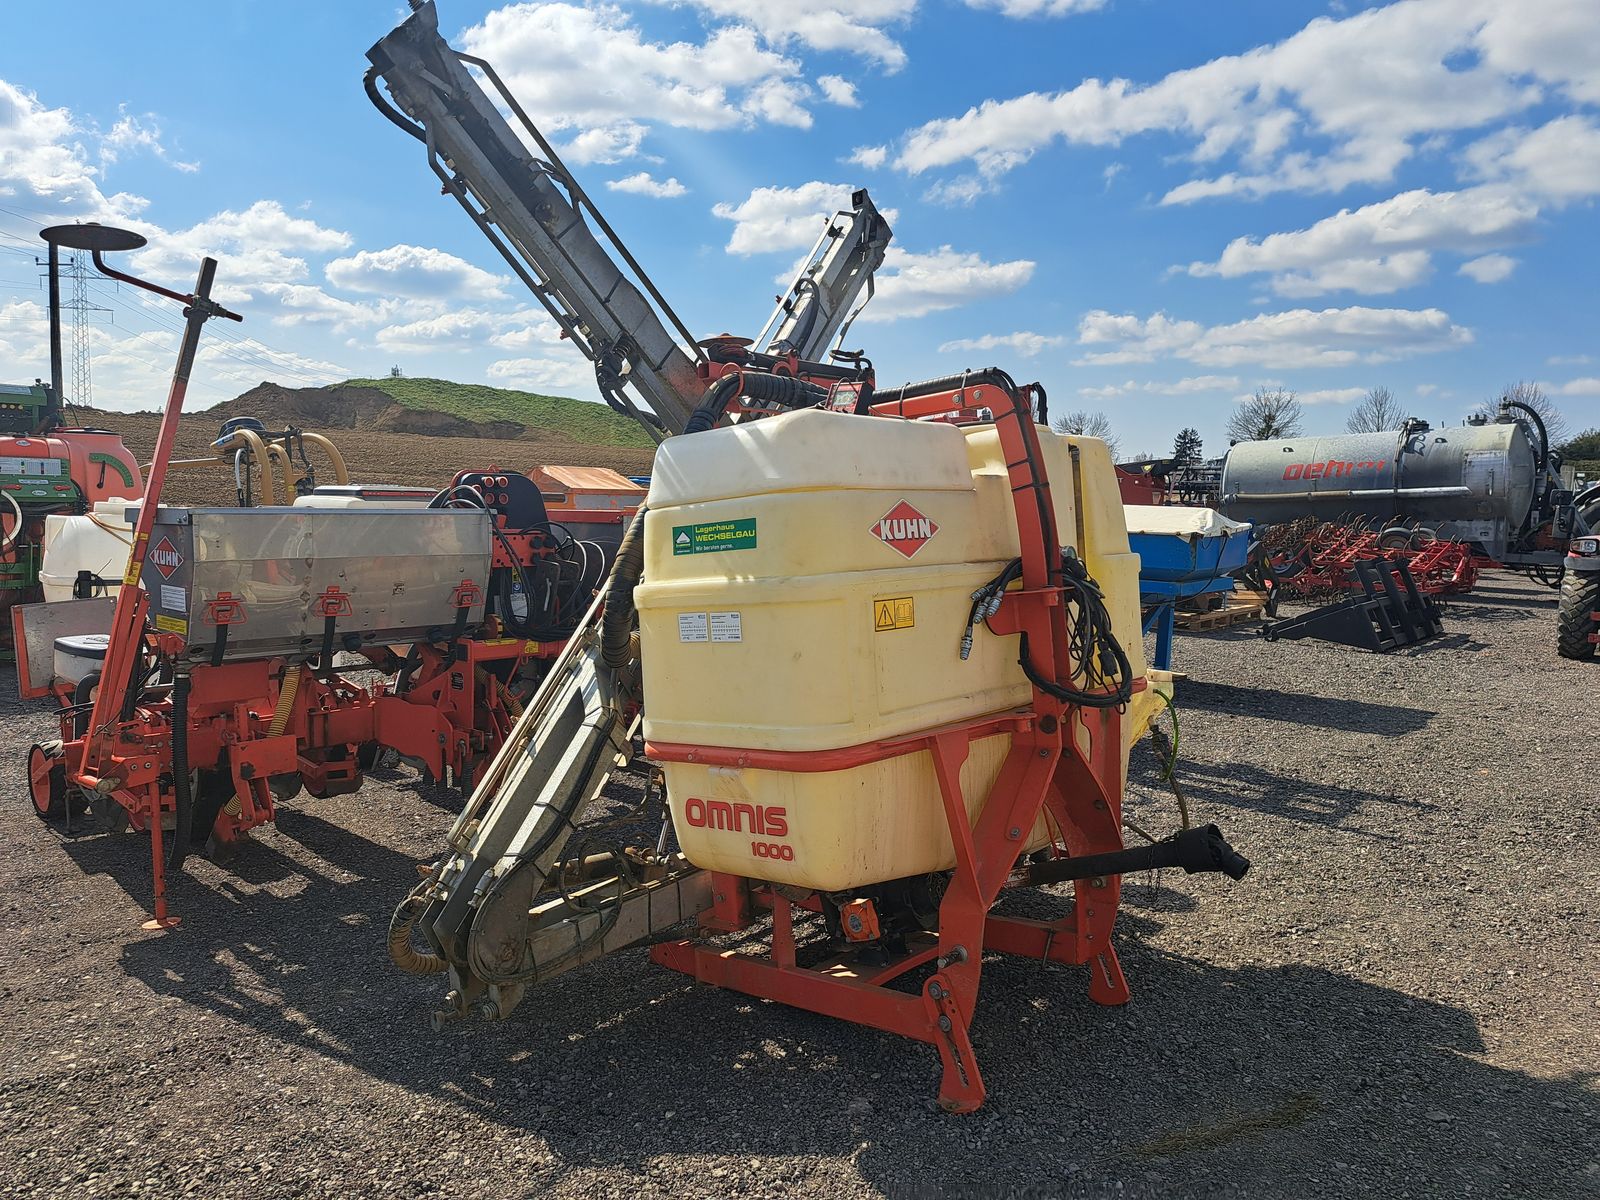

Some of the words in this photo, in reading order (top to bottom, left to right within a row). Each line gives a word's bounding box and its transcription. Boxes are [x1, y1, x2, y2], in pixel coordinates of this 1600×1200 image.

[695, 524, 735, 533] Lagerhaus
[695, 529, 755, 542] WECHSELGAU
[880, 518, 932, 541] KUHN
[154, 549, 179, 567] KUHN
[686, 798, 788, 836] OMNIS
[751, 841, 793, 861] 1000
